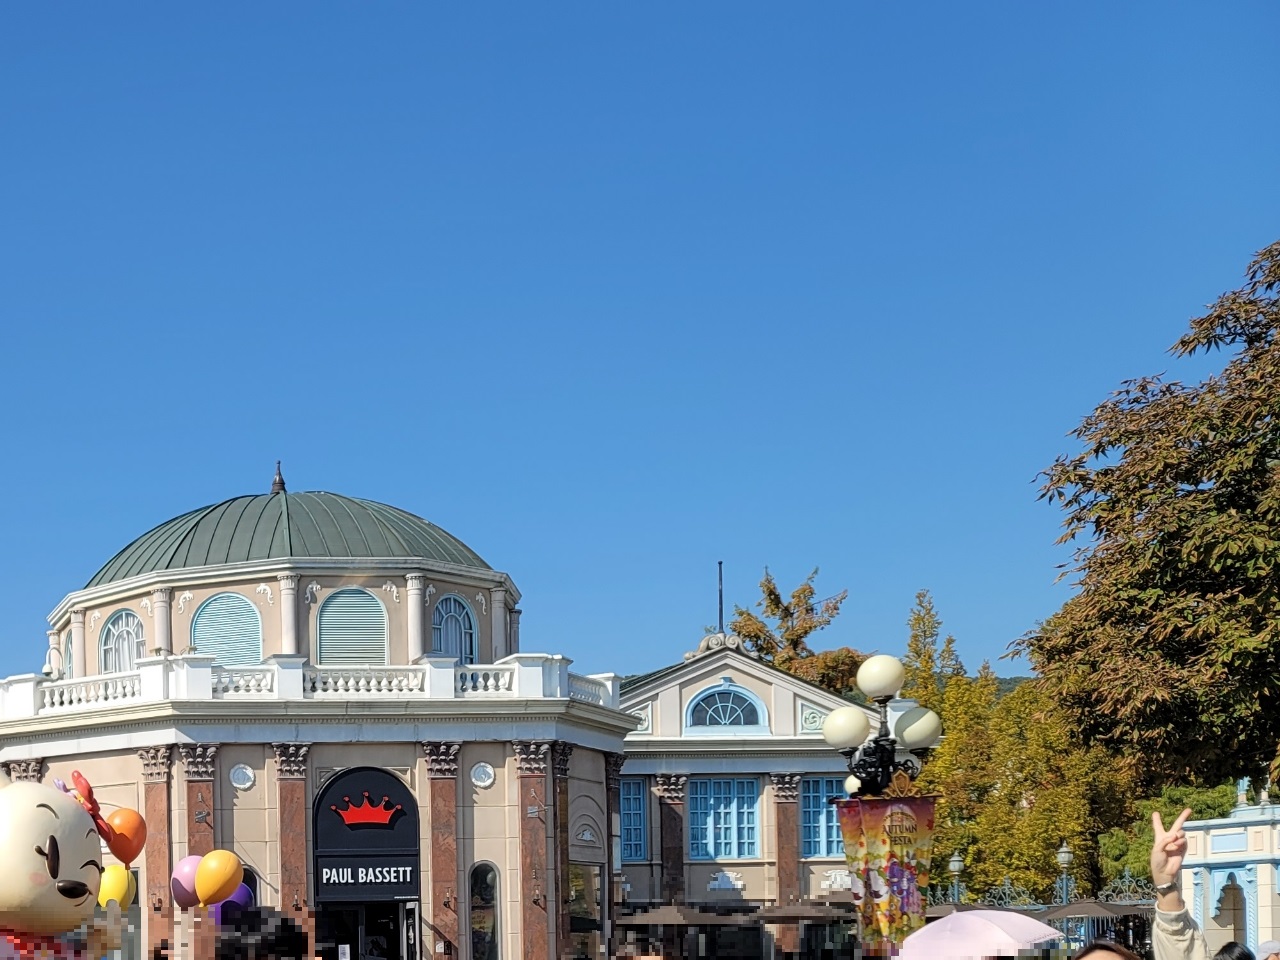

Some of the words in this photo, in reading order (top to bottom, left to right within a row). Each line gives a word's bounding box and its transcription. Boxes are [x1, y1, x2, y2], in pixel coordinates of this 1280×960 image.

[881, 823, 918, 838] AUTUMN
[322, 867, 355, 884] PAUL
[358, 866, 412, 883] BASSETT
